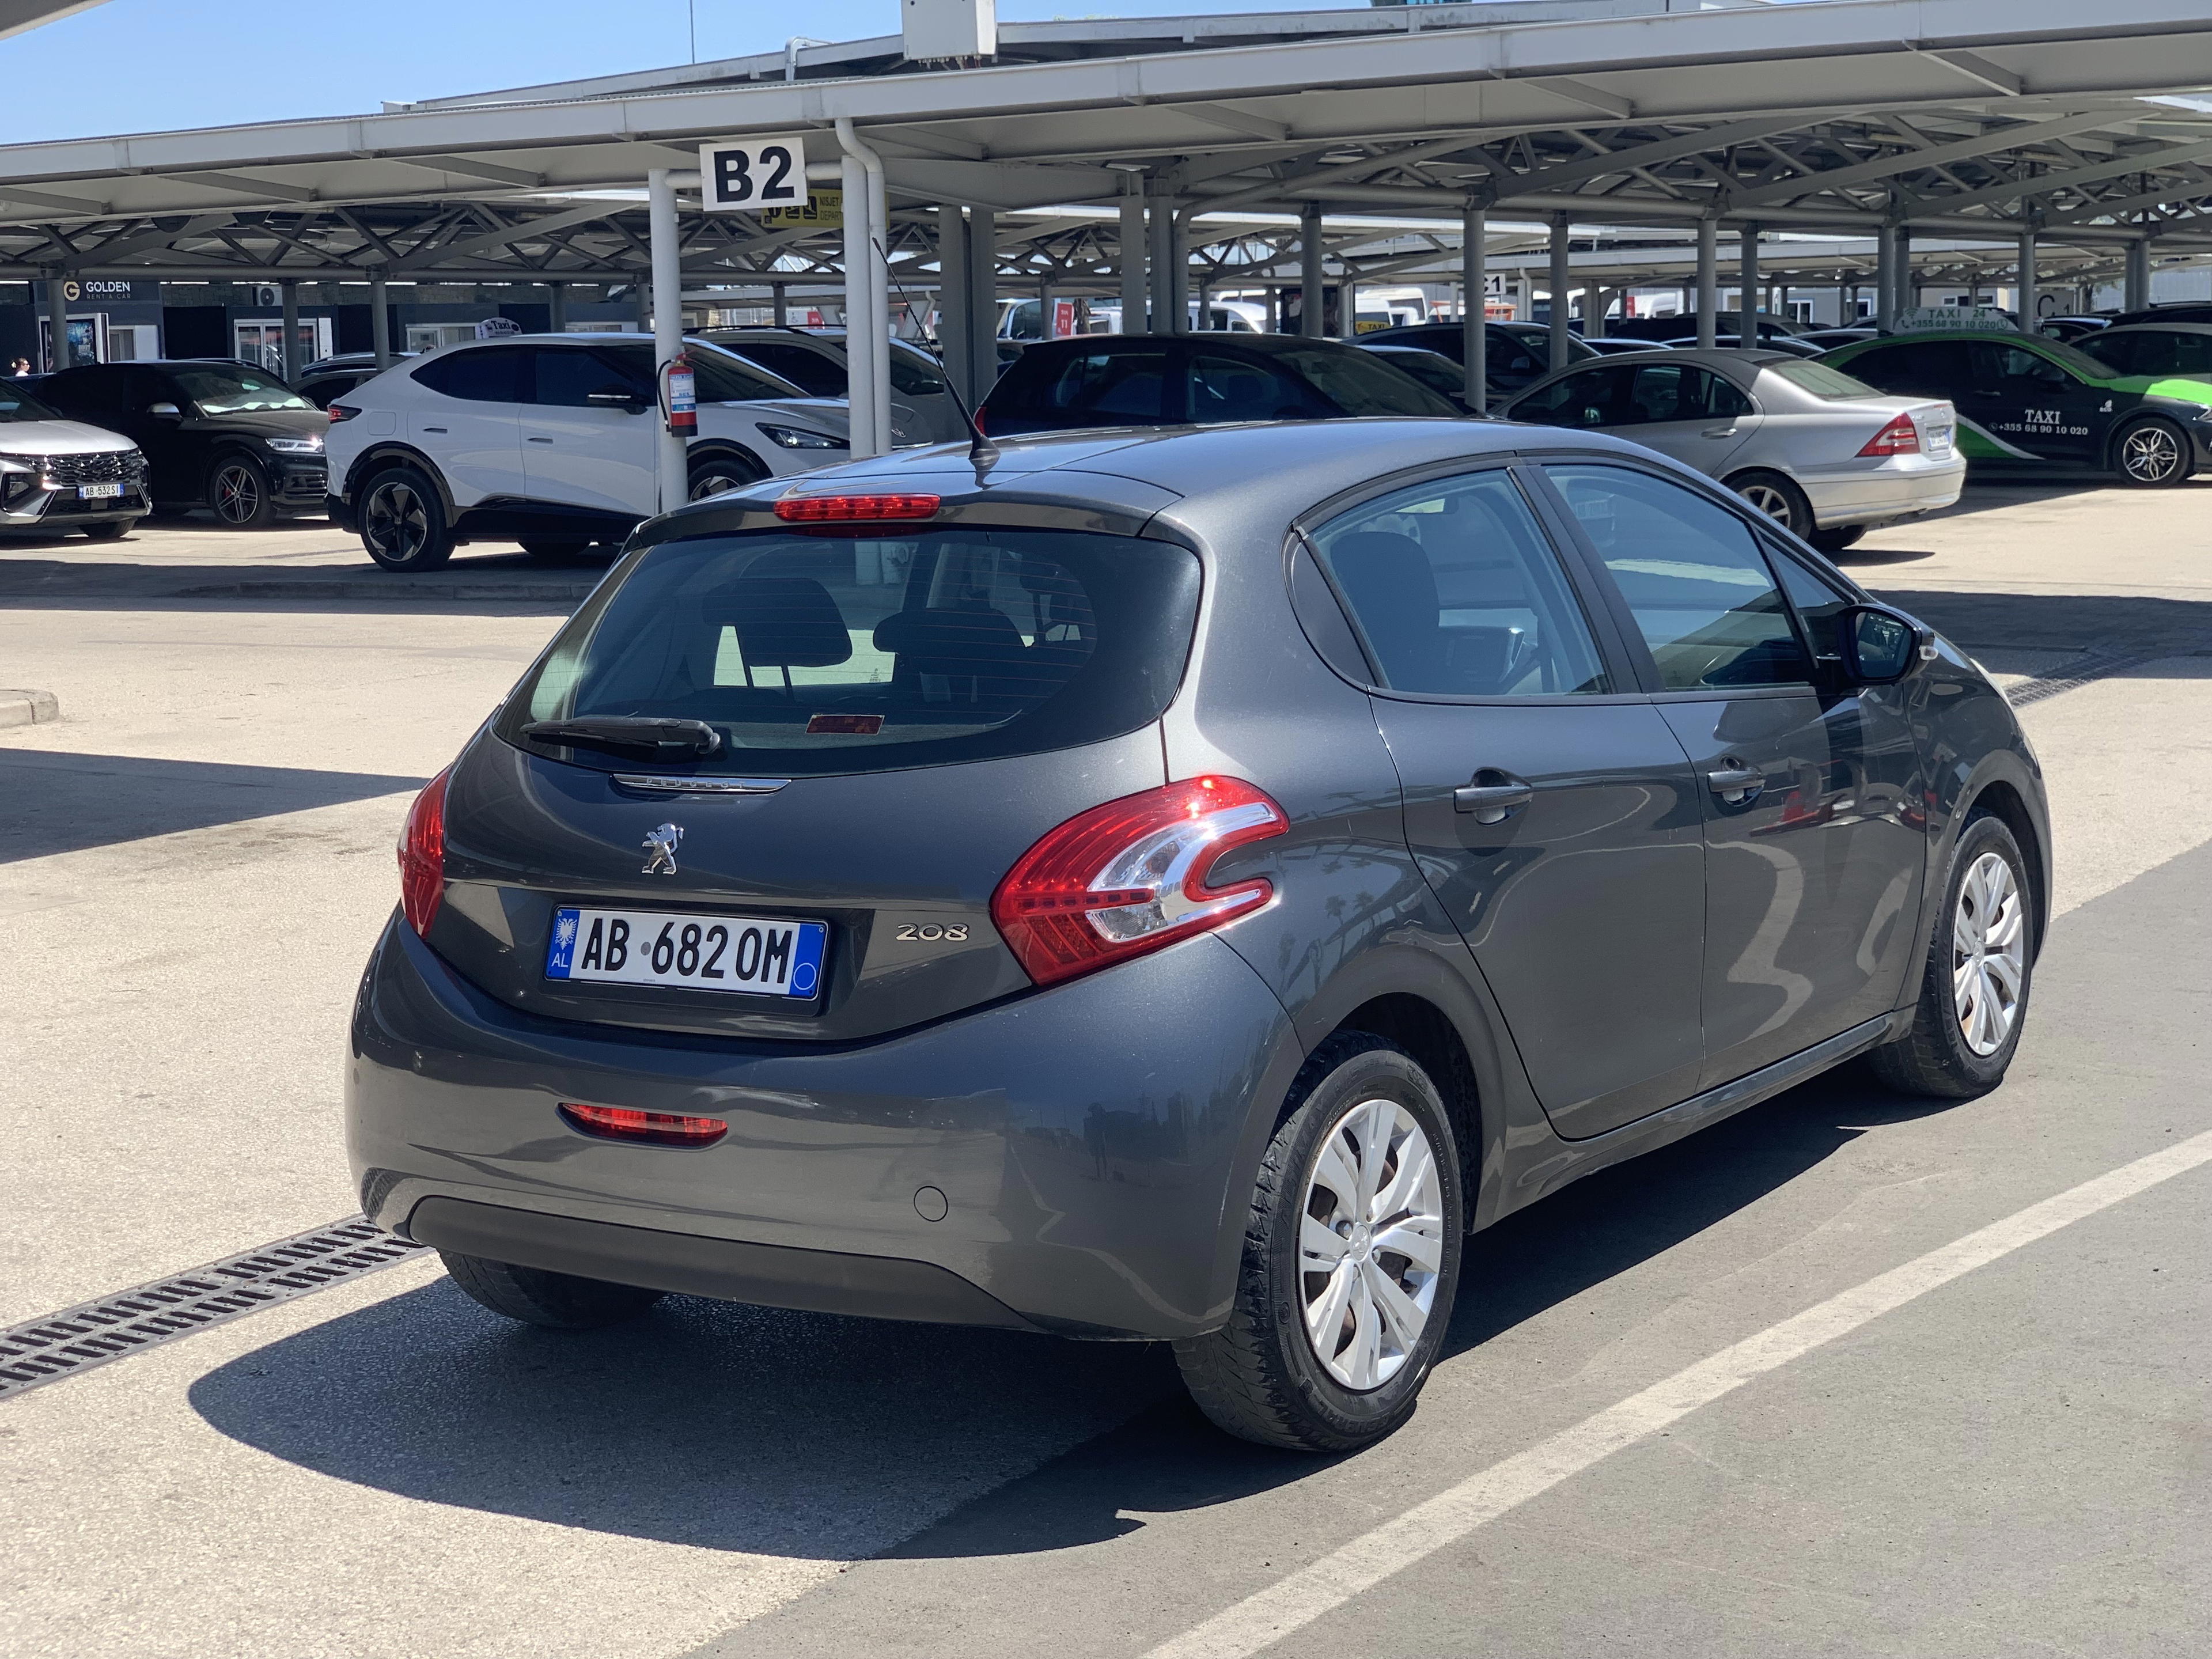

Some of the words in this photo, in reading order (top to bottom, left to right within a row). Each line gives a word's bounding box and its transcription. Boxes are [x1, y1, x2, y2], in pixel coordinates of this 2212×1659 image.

[713, 145, 795, 203] B2
[85, 281, 131, 293] GOLDEN
[1927, 309, 1961, 318] TAXI
[490, 320, 512, 330] Taxi
[1965, 320, 1976, 328] 10
[1978, 320, 1997, 329] 020
[2025, 409, 2061, 425] TAXI
[1998, 423, 2022, 431] +355
[2025, 424, 2037, 433] 68
[2040, 425, 2052, 433] 90
[2070, 427, 2088, 435] 020
[646, 778, 746, 789] PEUGEOT
[896, 923, 969, 941] 208
[581, 918, 630, 971] AB
[551, 952, 569, 968] AL
